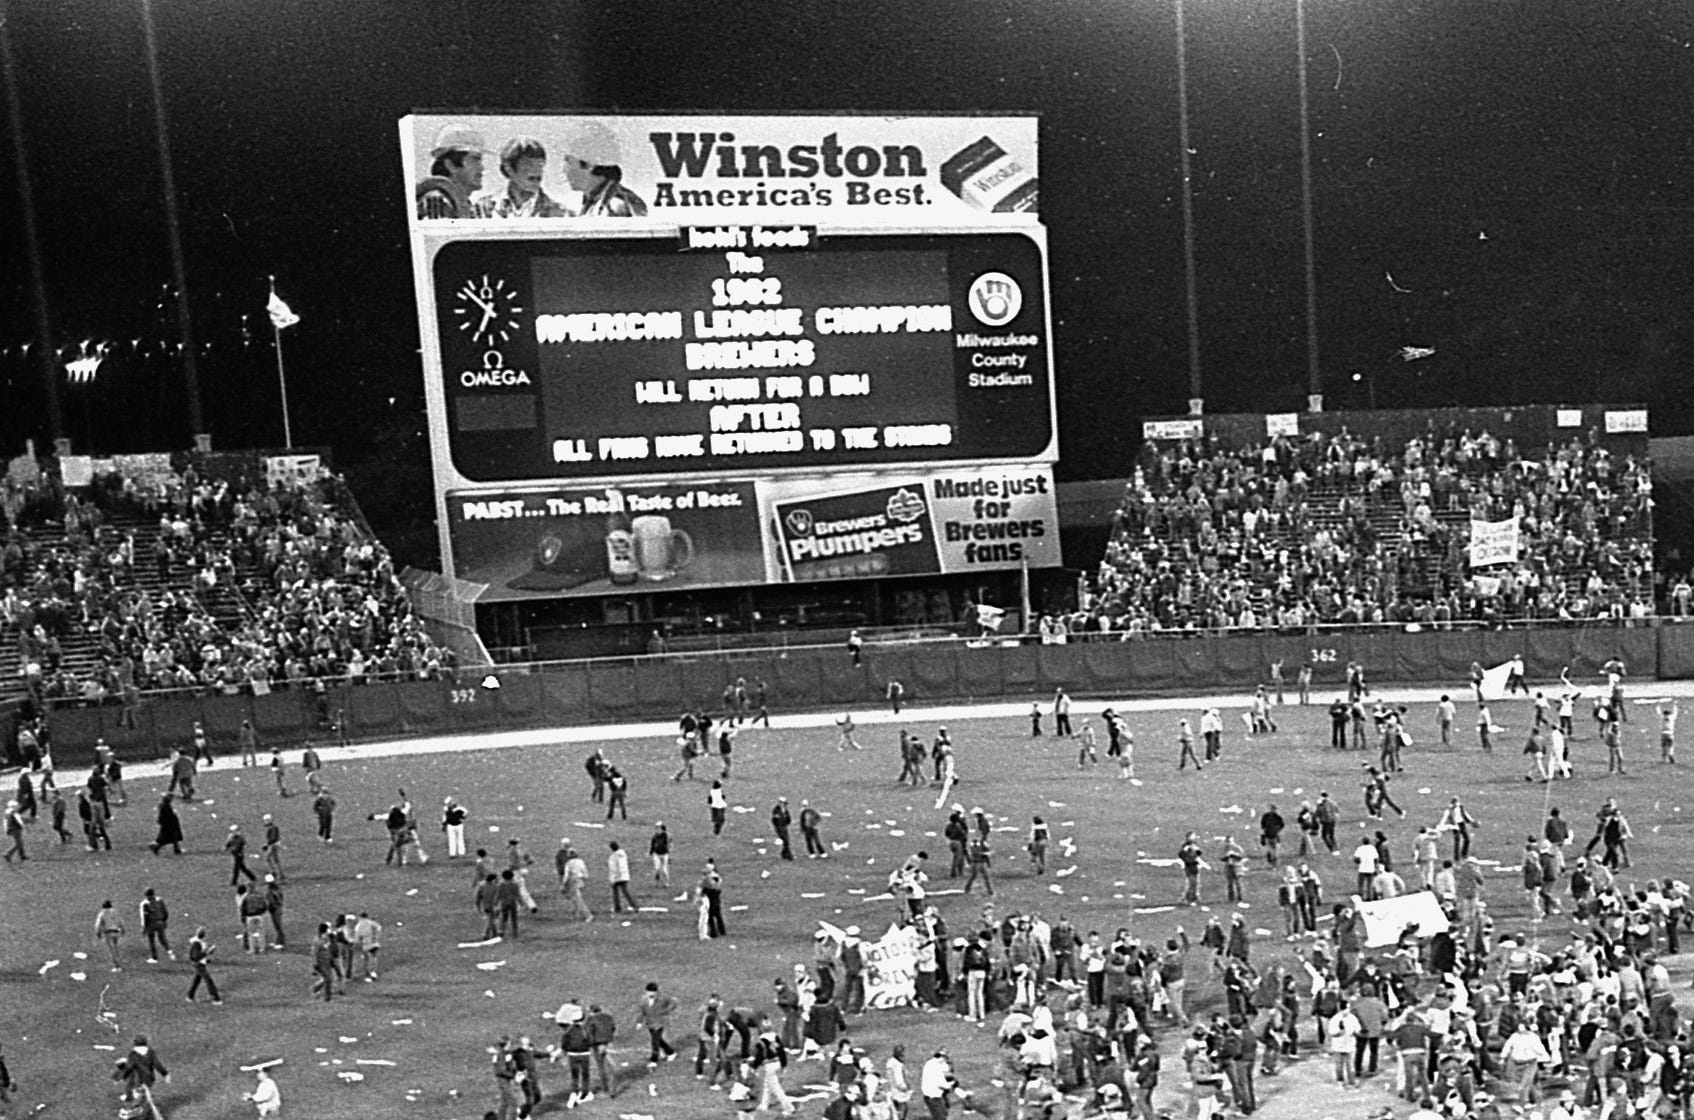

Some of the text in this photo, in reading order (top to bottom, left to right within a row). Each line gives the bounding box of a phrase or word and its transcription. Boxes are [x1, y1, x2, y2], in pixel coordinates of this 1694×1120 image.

[649, 132, 927, 178] Winston
[653, 181, 932, 207] America's Best.
[711, 277, 783, 306] 1982
[535, 305, 952, 343] AMERICAN LEAGUE CHAMPION
[956, 333, 1038, 348] Milwaukee
[685, 339, 816, 370] BREWERS
[972, 352, 1027, 369] County
[460, 369, 531, 387] OMEGA
[635, 380, 683, 404] WILL
[688, 377, 760, 401] RETURN
[968, 373, 1033, 388] Stadium
[709, 402, 801, 432] AFTER
[934, 474, 1048, 499] Made just
[546, 498, 582, 517] The
[584, 491, 625, 514] Real
[627, 494, 673, 512] Taste
[676, 491, 695, 508] of
[973, 499, 1012, 519] for
[814, 513, 887, 536] Brewers
[945, 519, 1045, 542] Brewers
[789, 522, 923, 561] Plumpers
[1310, 649, 1337, 662] 362
[450, 688, 476, 704] 392
